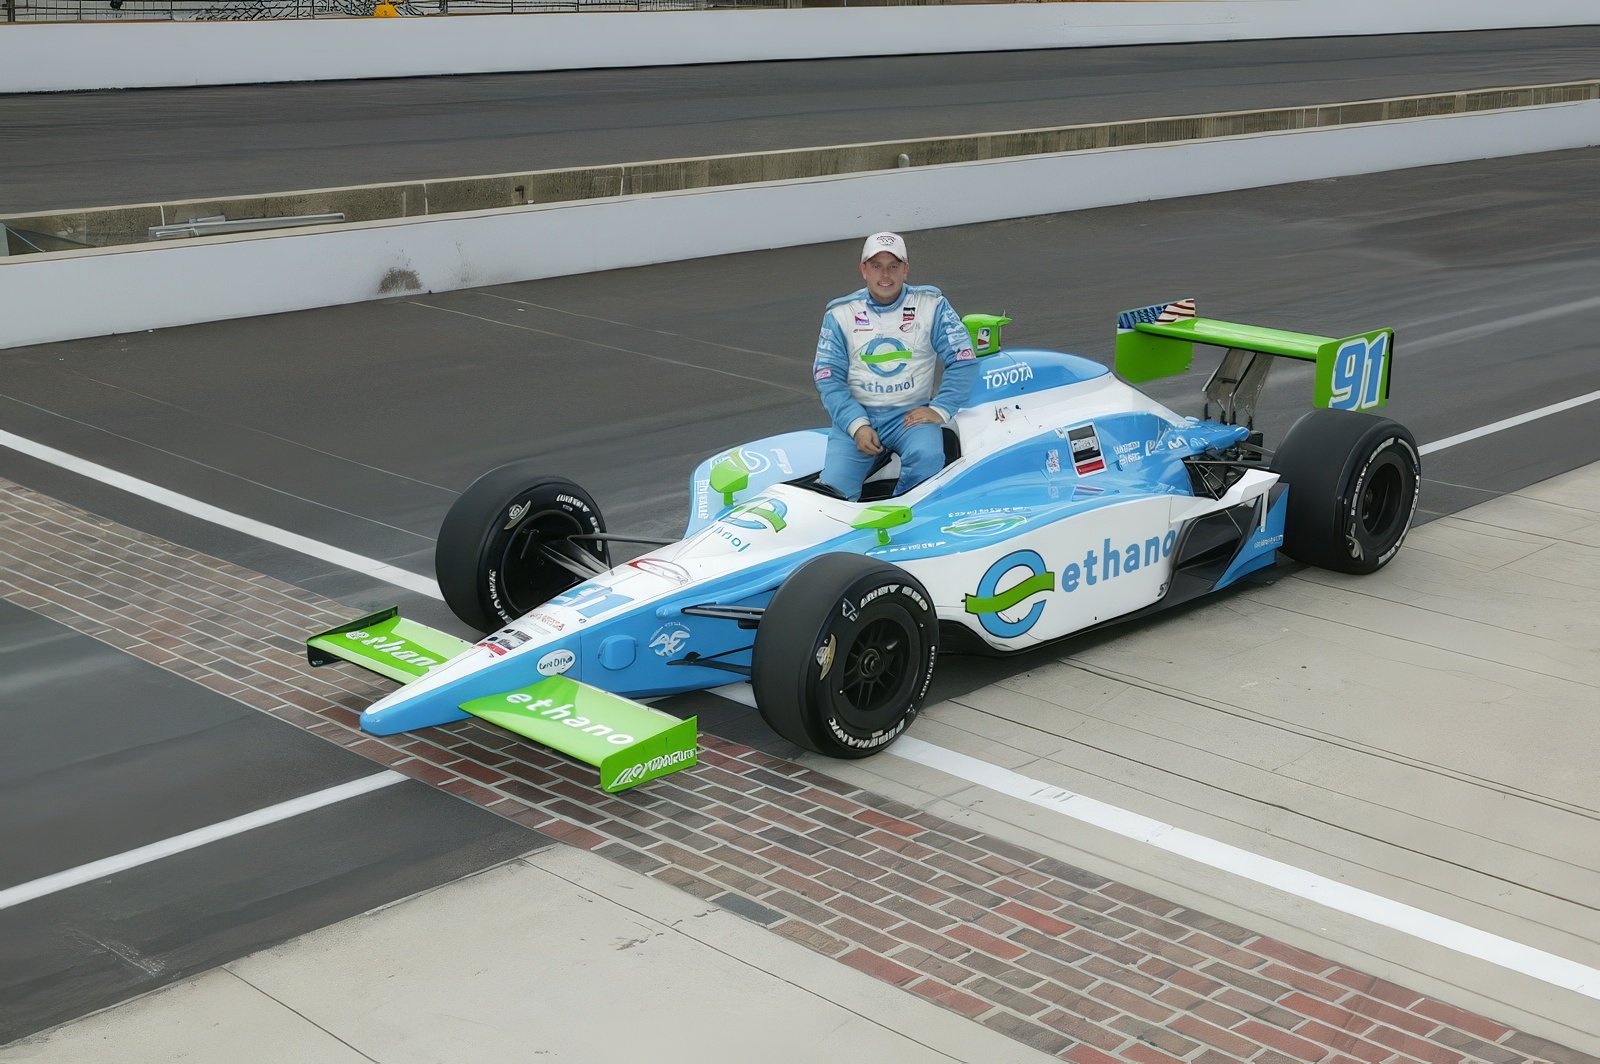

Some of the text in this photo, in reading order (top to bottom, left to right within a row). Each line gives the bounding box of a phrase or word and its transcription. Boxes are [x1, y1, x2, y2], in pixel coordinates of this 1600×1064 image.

[983, 366, 1033, 389] TOYOTA
[1329, 331, 1388, 410] 91
[1061, 529, 1176, 592] ethano
[506, 693, 635, 745] ethano
